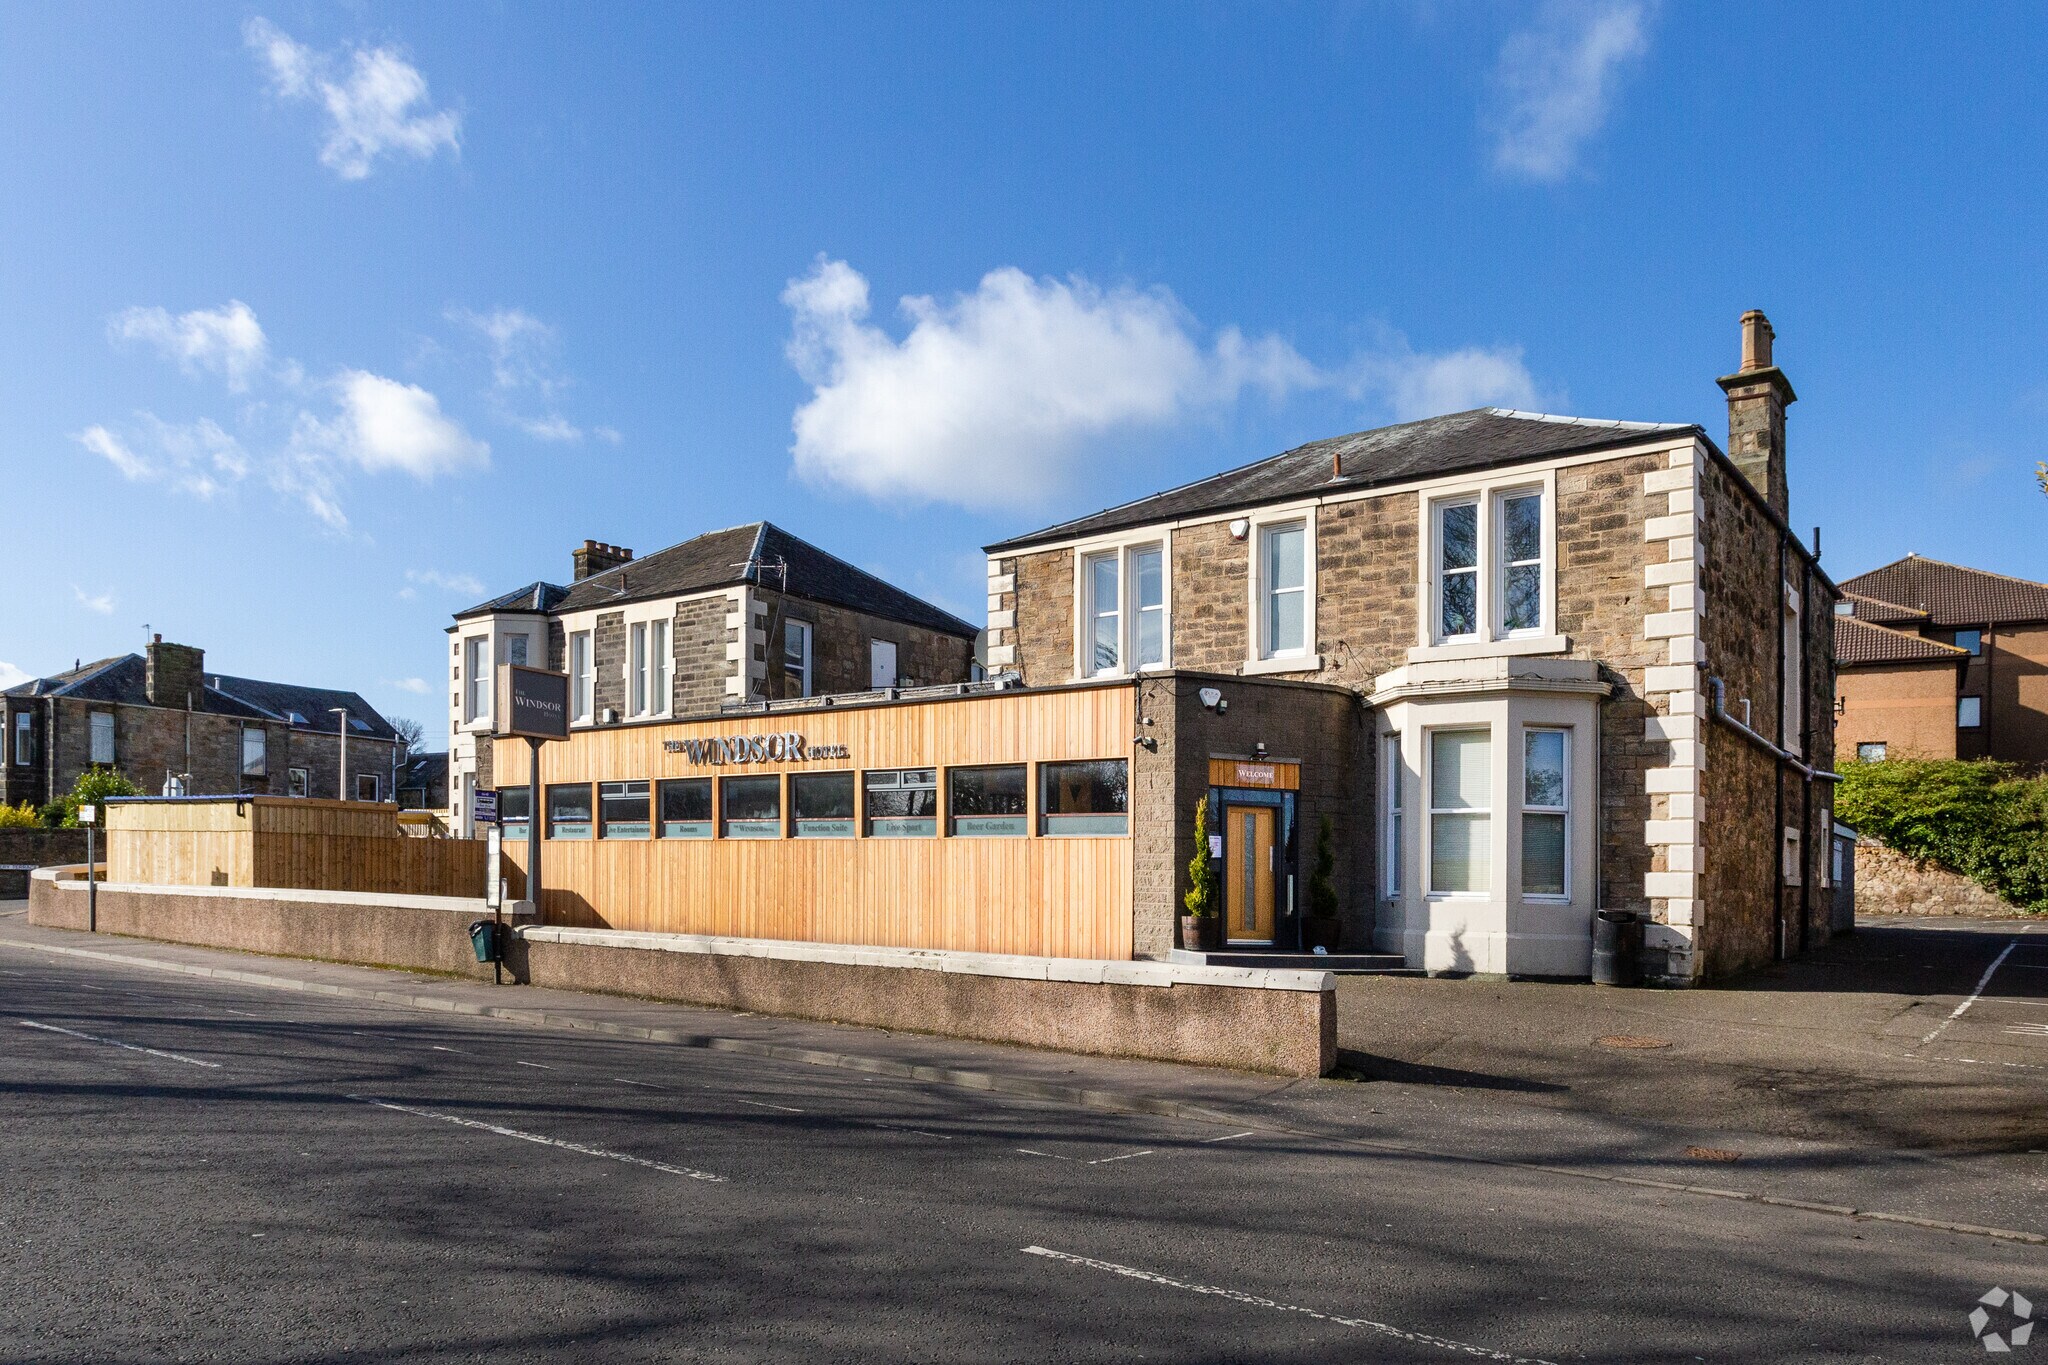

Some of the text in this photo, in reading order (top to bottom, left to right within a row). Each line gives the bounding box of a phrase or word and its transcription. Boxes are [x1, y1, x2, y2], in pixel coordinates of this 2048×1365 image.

[515, 696, 562, 712] WINDSOR
[683, 731, 806, 765] WINDSOR
[807, 743, 850, 759] HOTEL
[1238, 769, 1274, 778] WELCOME
[562, 826, 586, 834] Restaurant
[617, 825, 650, 833] Entertainmen
[680, 825, 697, 833] Rooms
[803, 823, 848, 832] Function Suite
[886, 823, 922, 834] Live Sport
[966, 821, 1015, 831] Beer Garden
